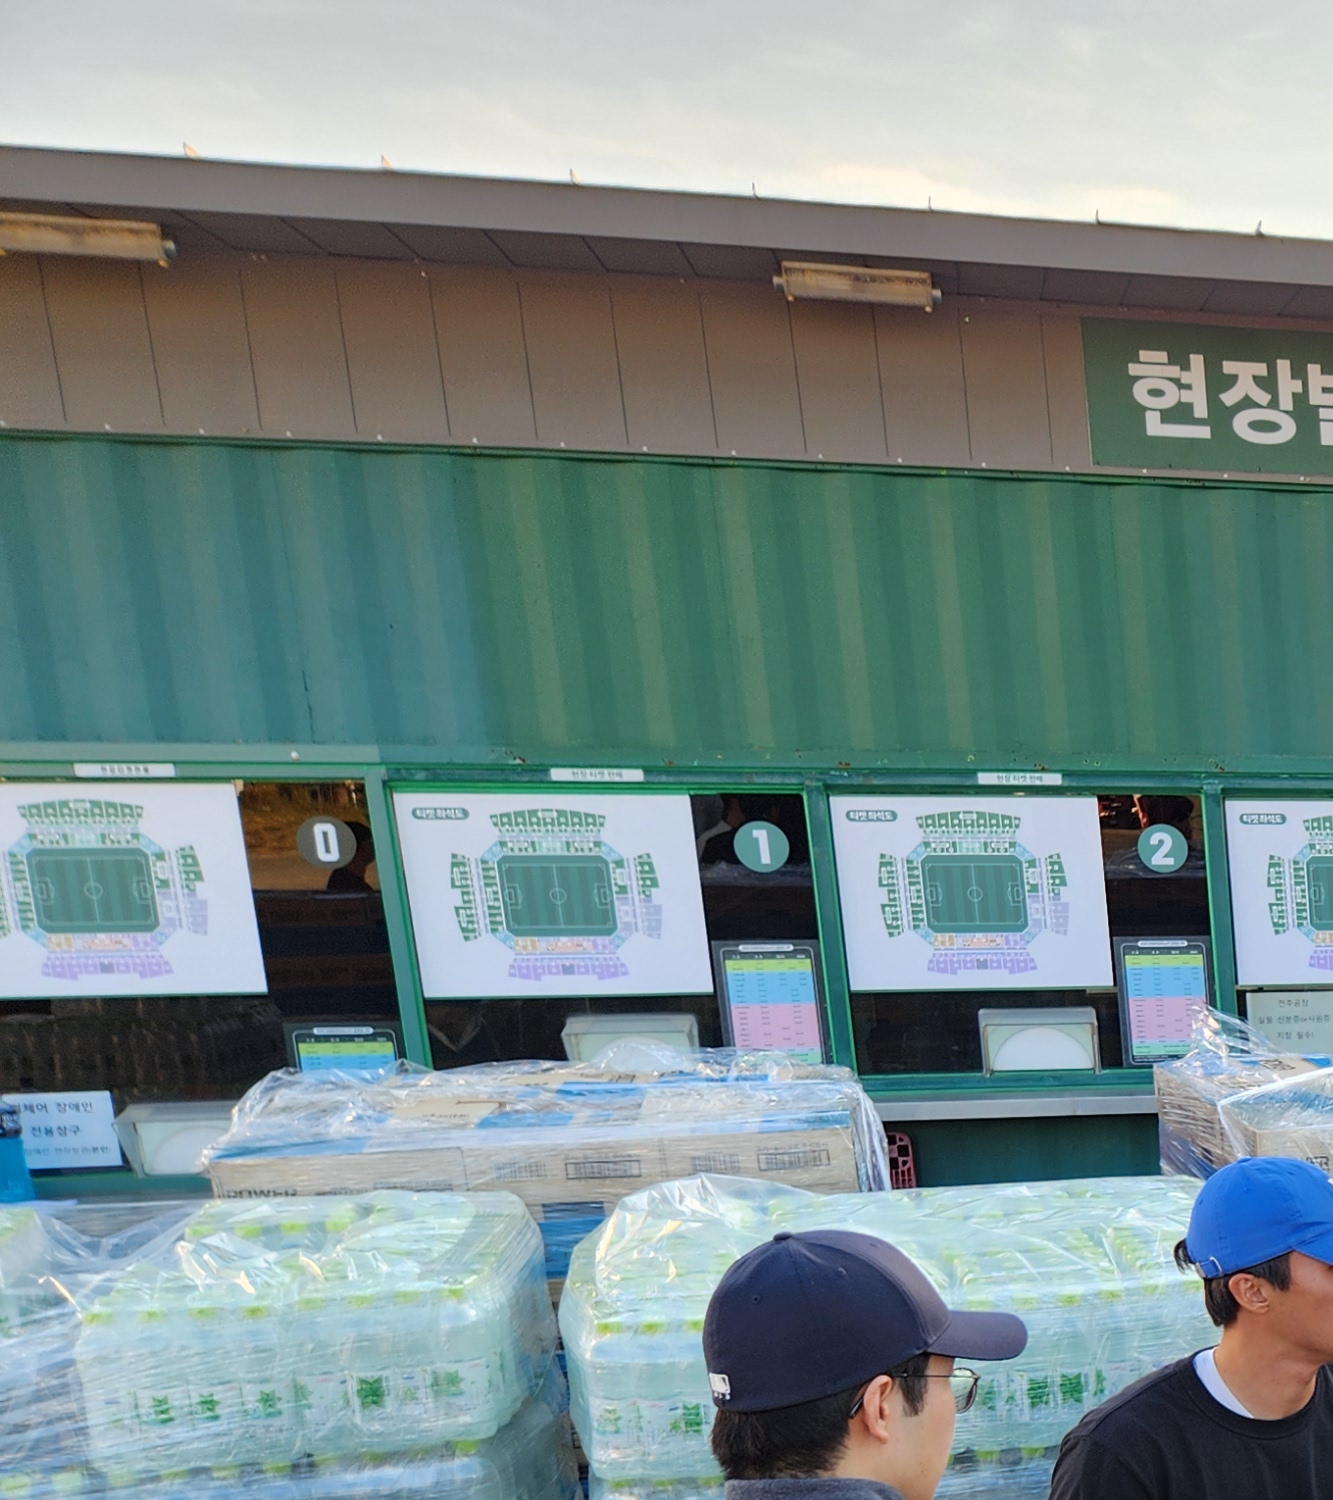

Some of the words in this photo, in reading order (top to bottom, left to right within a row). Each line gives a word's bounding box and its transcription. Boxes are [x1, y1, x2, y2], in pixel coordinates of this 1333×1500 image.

[313, 822, 340, 862] 0
[752, 829, 771, 865] 1
[1149, 832, 1175, 866] 2
